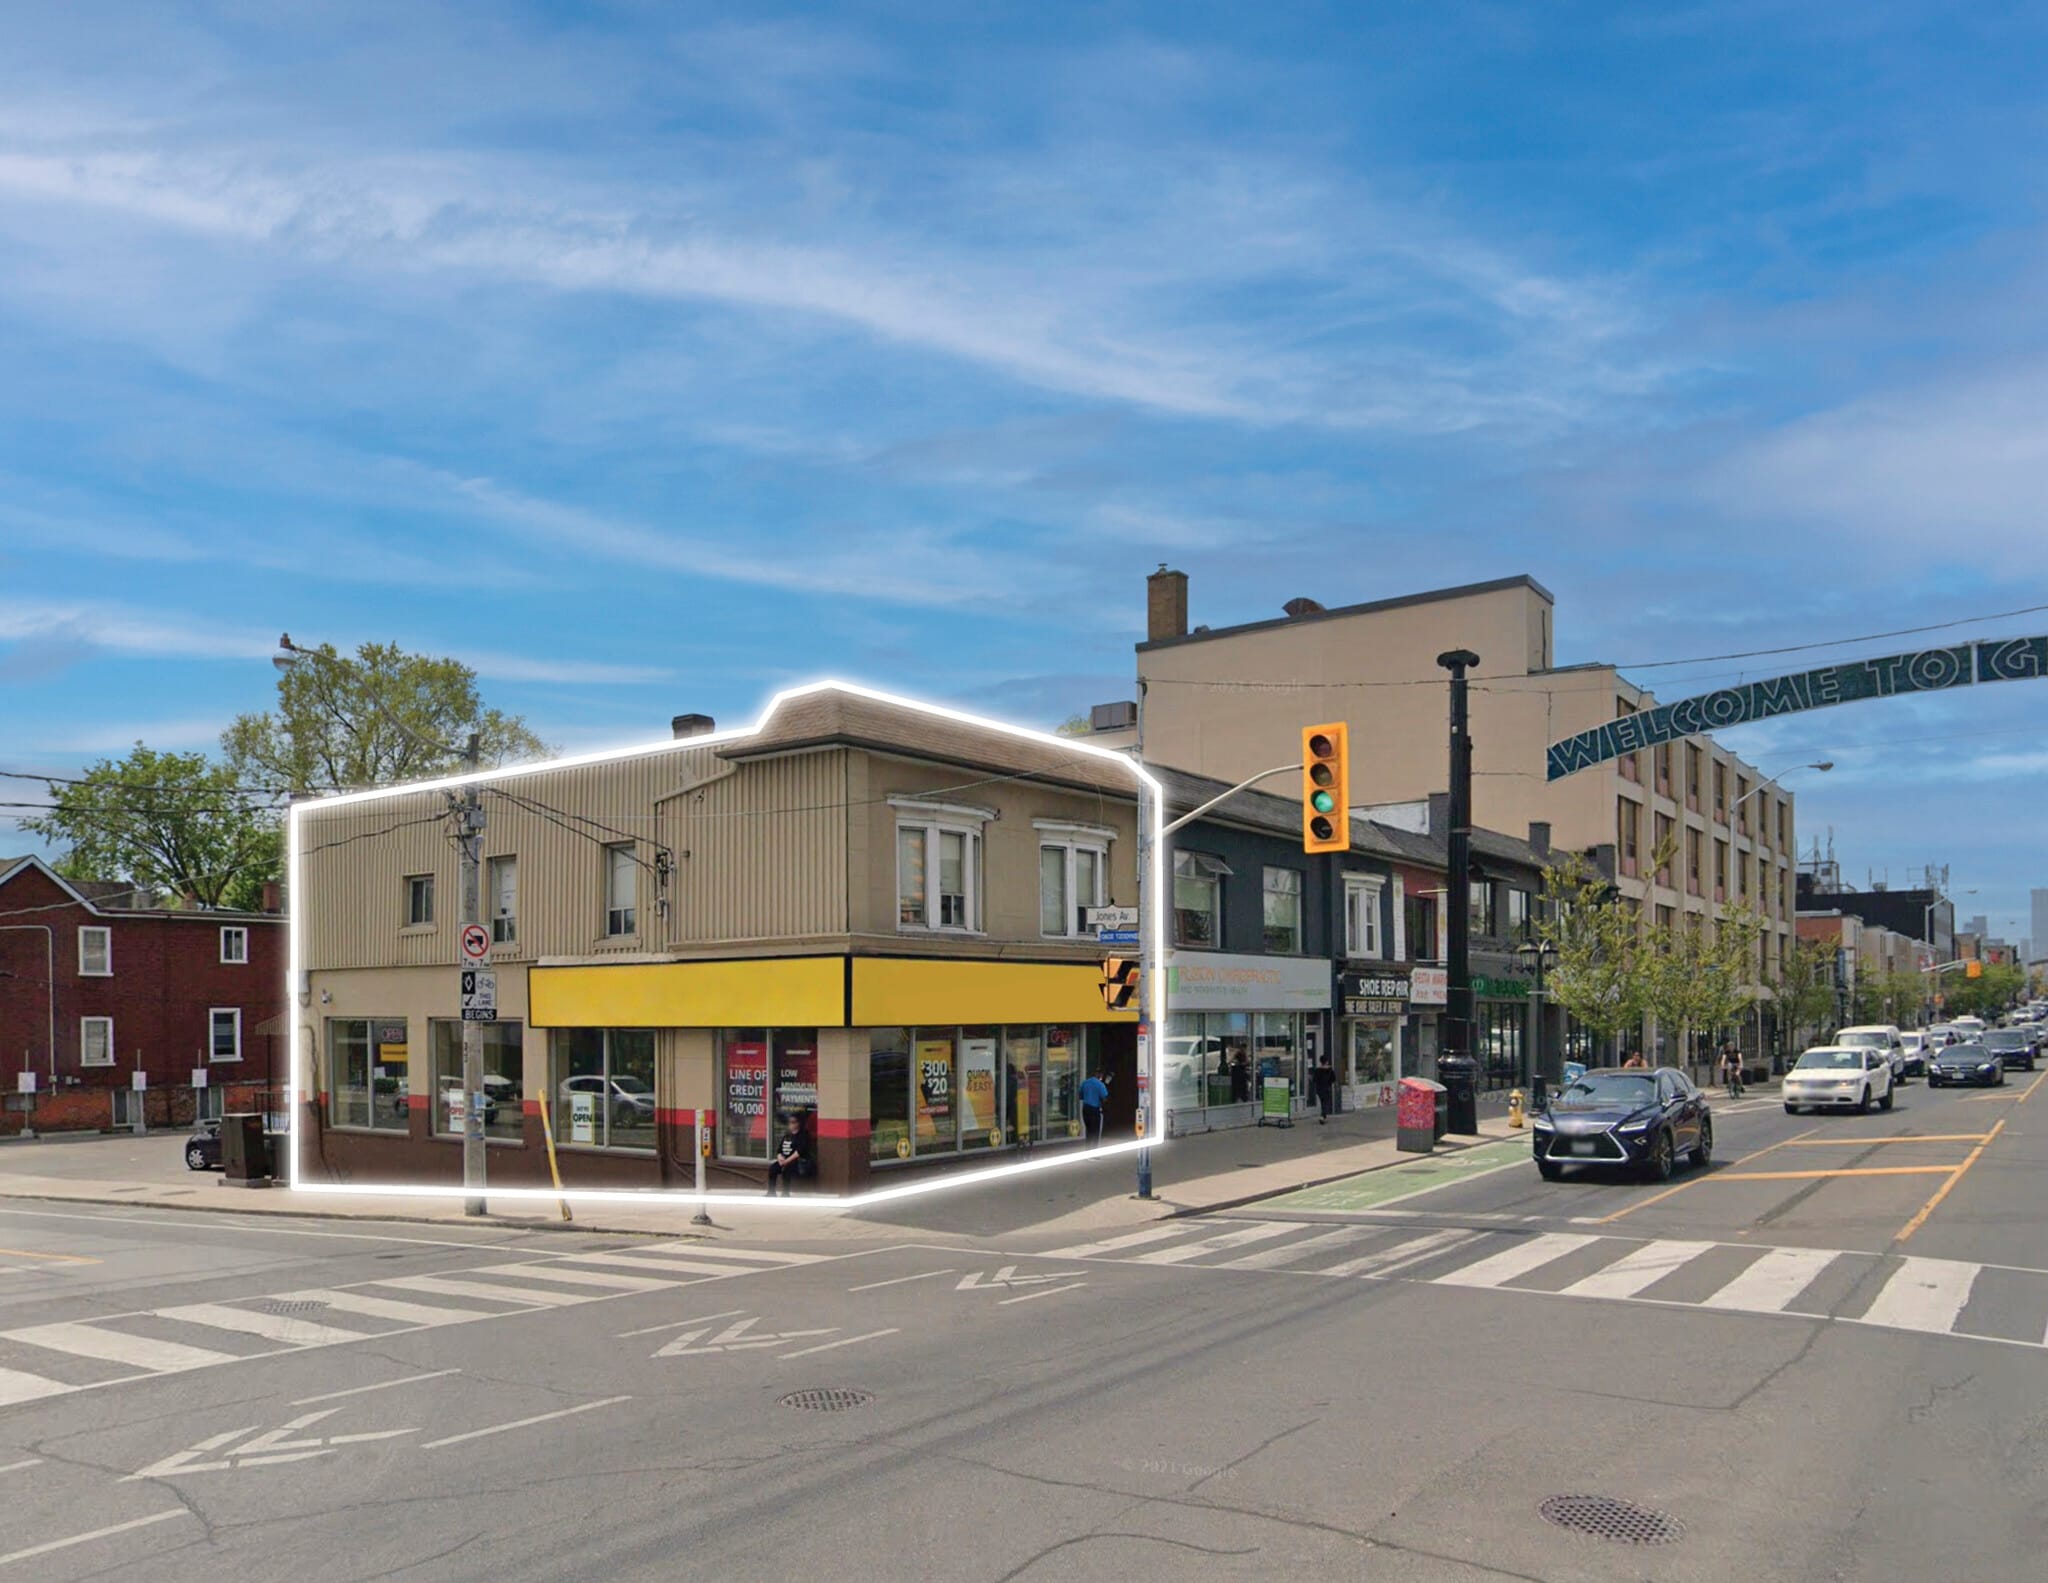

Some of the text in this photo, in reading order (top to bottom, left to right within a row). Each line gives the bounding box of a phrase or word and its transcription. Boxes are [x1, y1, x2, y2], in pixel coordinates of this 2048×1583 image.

[1549, 666, 1841, 774] WELCOME
[1865, 648, 1960, 697] TO
[1096, 911, 1117, 921] Jones
[1359, 978, 1380, 996] SHOE
[1381, 979, 1409, 998] REPAIR
[464, 1010, 495, 1019] BEGINS
[729, 1069, 767, 1080] LINE OF
[780, 1069, 798, 1078] LOW
[921, 1060, 948, 1077] $300
[967, 1069, 991, 1081] QUICK
[729, 1084, 764, 1096] CREDIT
[927, 1077, 948, 1095] $20
[973, 1081, 992, 1092] EASY
[729, 1101, 764, 1115] $10,000
[573, 1112, 593, 1122] OPEN
